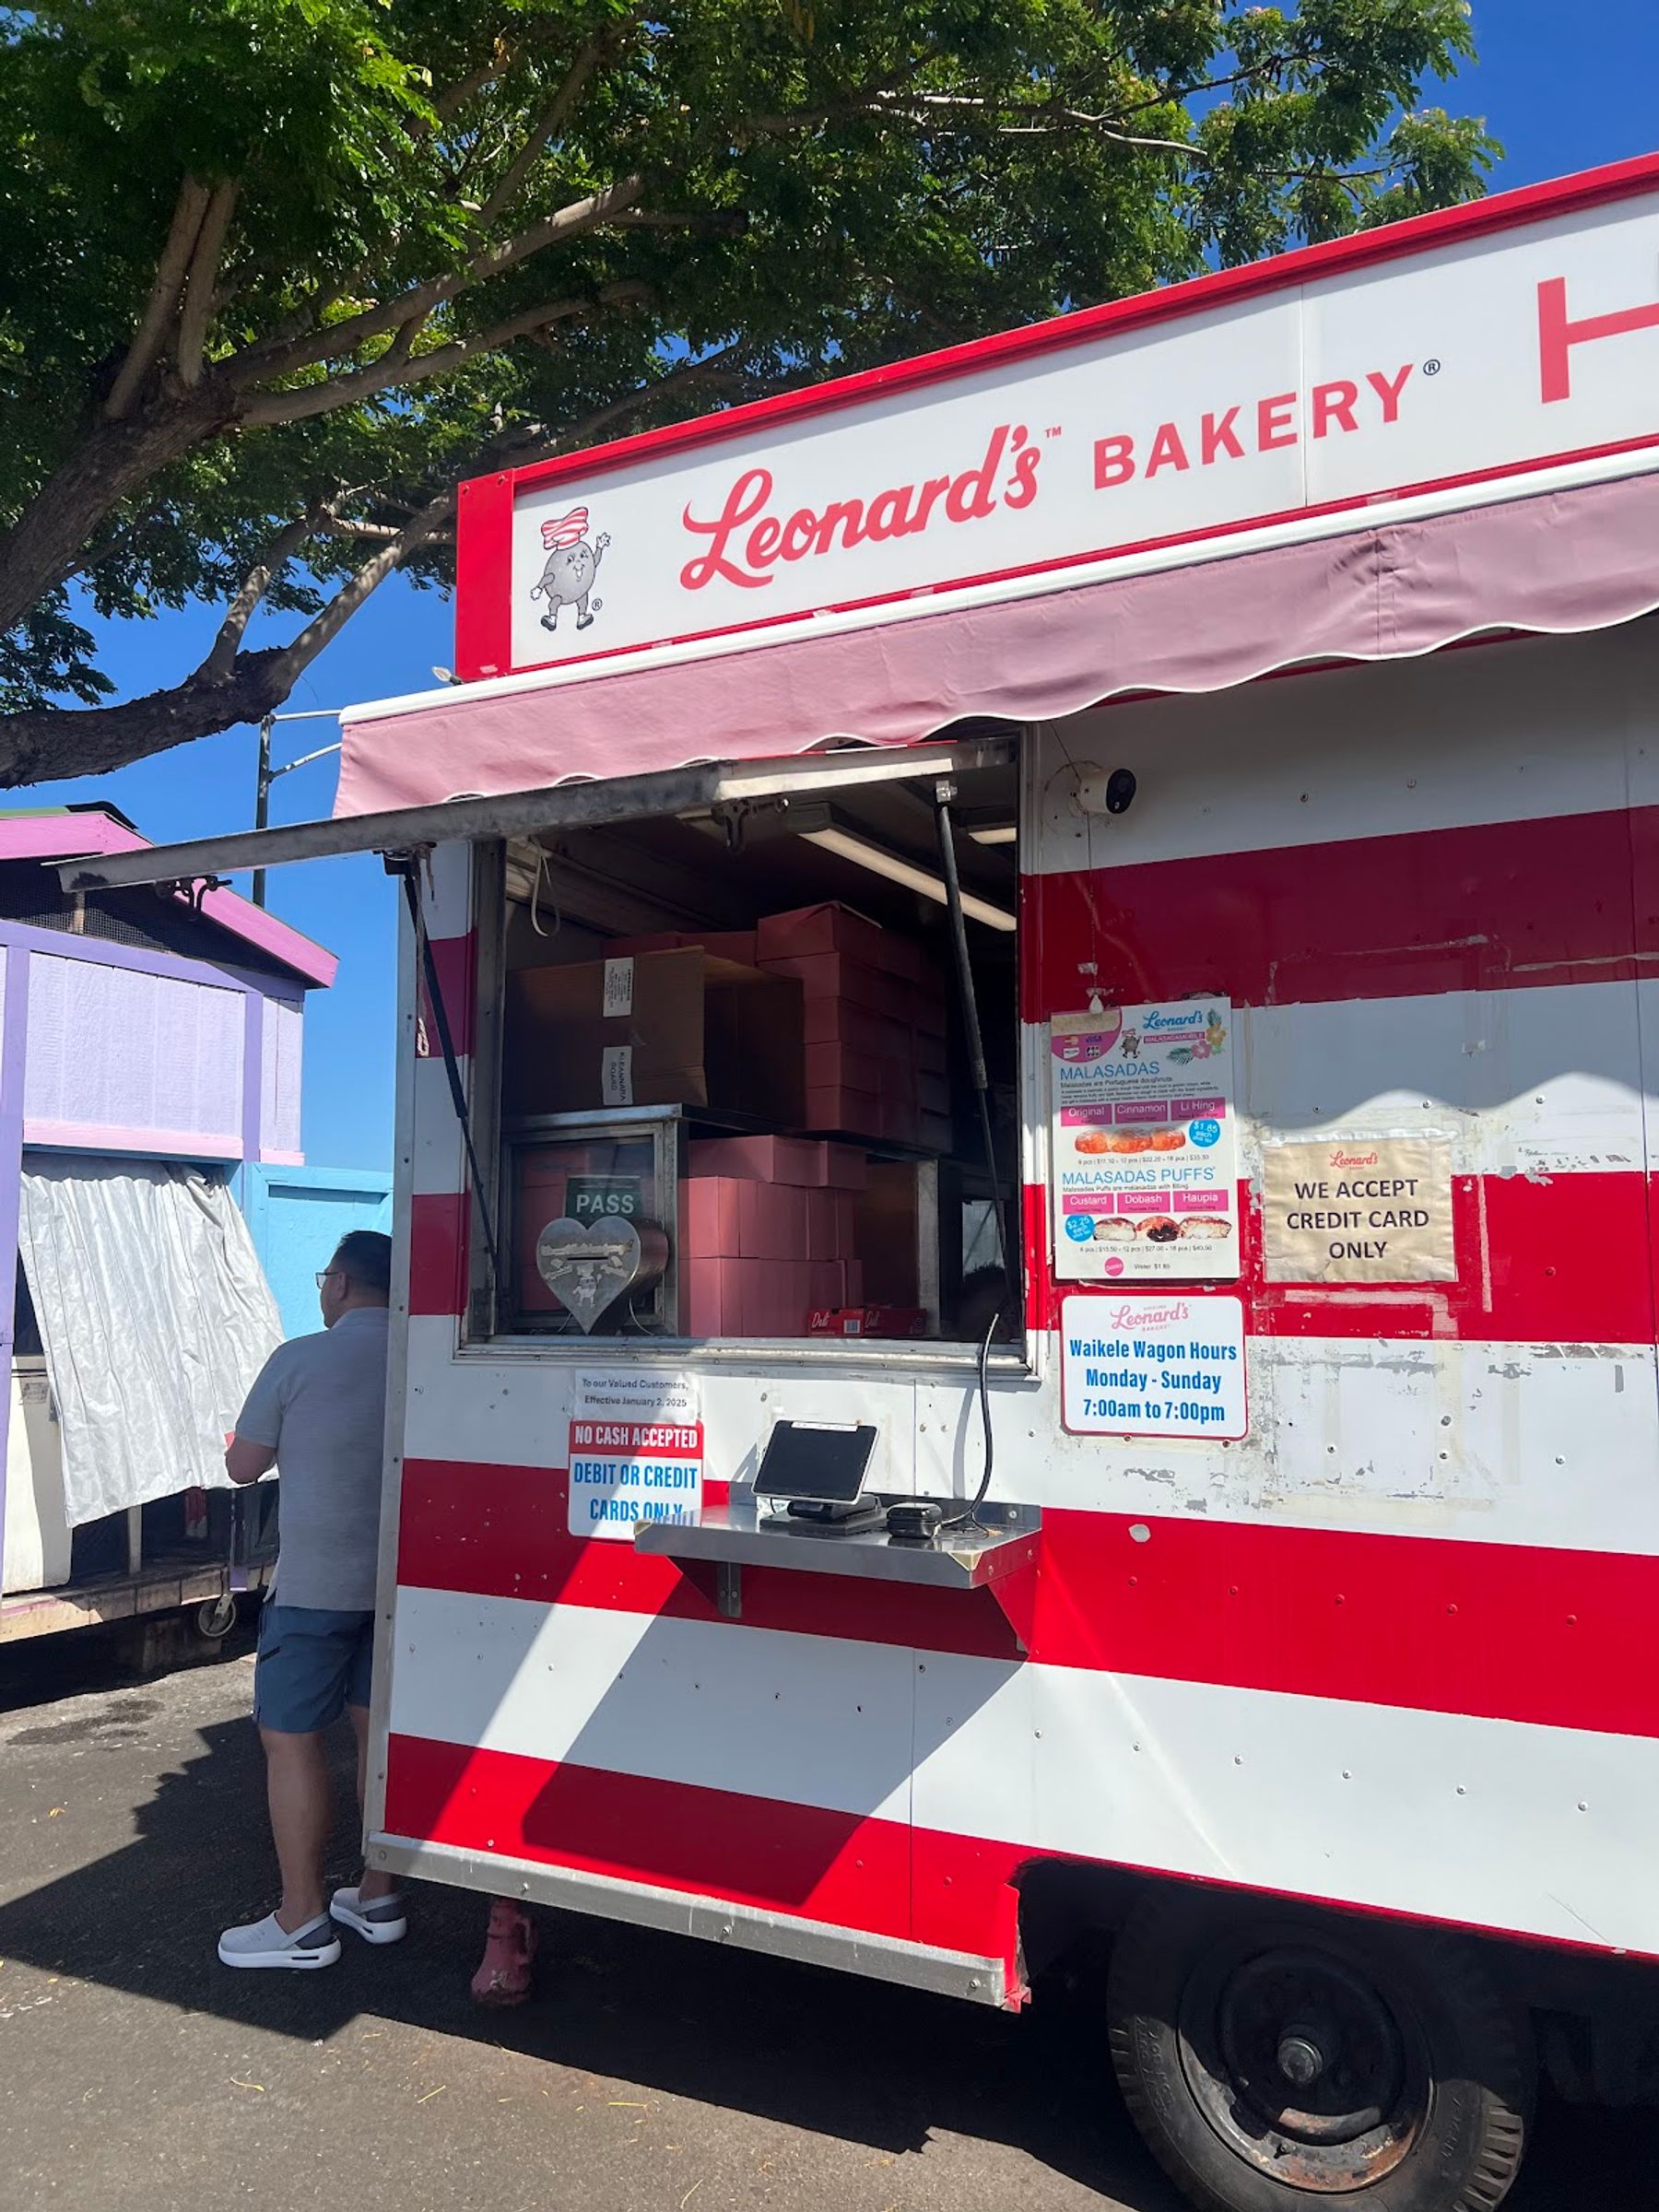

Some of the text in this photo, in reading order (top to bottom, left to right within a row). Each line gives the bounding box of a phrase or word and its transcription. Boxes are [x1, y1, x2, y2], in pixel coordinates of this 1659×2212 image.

[680, 425, 1041, 591] Leonard's
[1093, 364, 1415, 489] BAKERY
[1143, 1010, 1203, 1030] Leonard's
[1060, 1061, 1159, 1080] MALASADAS
[1068, 1107, 1104, 1118] Original
[1117, 1102, 1166, 1114] Cinnamon
[1194, 1100, 1215, 1112] Hing
[1329, 1150, 1379, 1169] Leonard's
[1062, 1167, 1214, 1185] MALASADAS PUFFS
[1182, 1193, 1218, 1203] Haupia
[1294, 1179, 1418, 1199] WE ACCEPT
[576, 1194, 634, 1214] PASS
[1070, 1194, 1107, 1206] Custard
[1124, 1194, 1162, 1204] Dobash
[1287, 1210, 1430, 1230] CREDIT CARD
[1329, 1241, 1387, 1259] ONLY
[1110, 1301, 1190, 1331] Leonard's
[1069, 1339, 1237, 1363] Waikele Wagon Hours
[582, 1378, 591, 1387] To
[608, 1379, 638, 1389] Valued
[1086, 1369, 1147, 1392] Monday
[1160, 1370, 1221, 1394] Sunday
[584, 1394, 620, 1406] Effective
[622, 1395, 655, 1407] January
[666, 1397, 688, 1407] 2025
[1083, 1398, 1225, 1425] 7:00am to 7:00pm
[575, 1426, 698, 1449] NO CASH ACCEPTED
[573, 1462, 698, 1488] DEBIT OR CREDIT
[590, 1499, 639, 1523] CARDS
